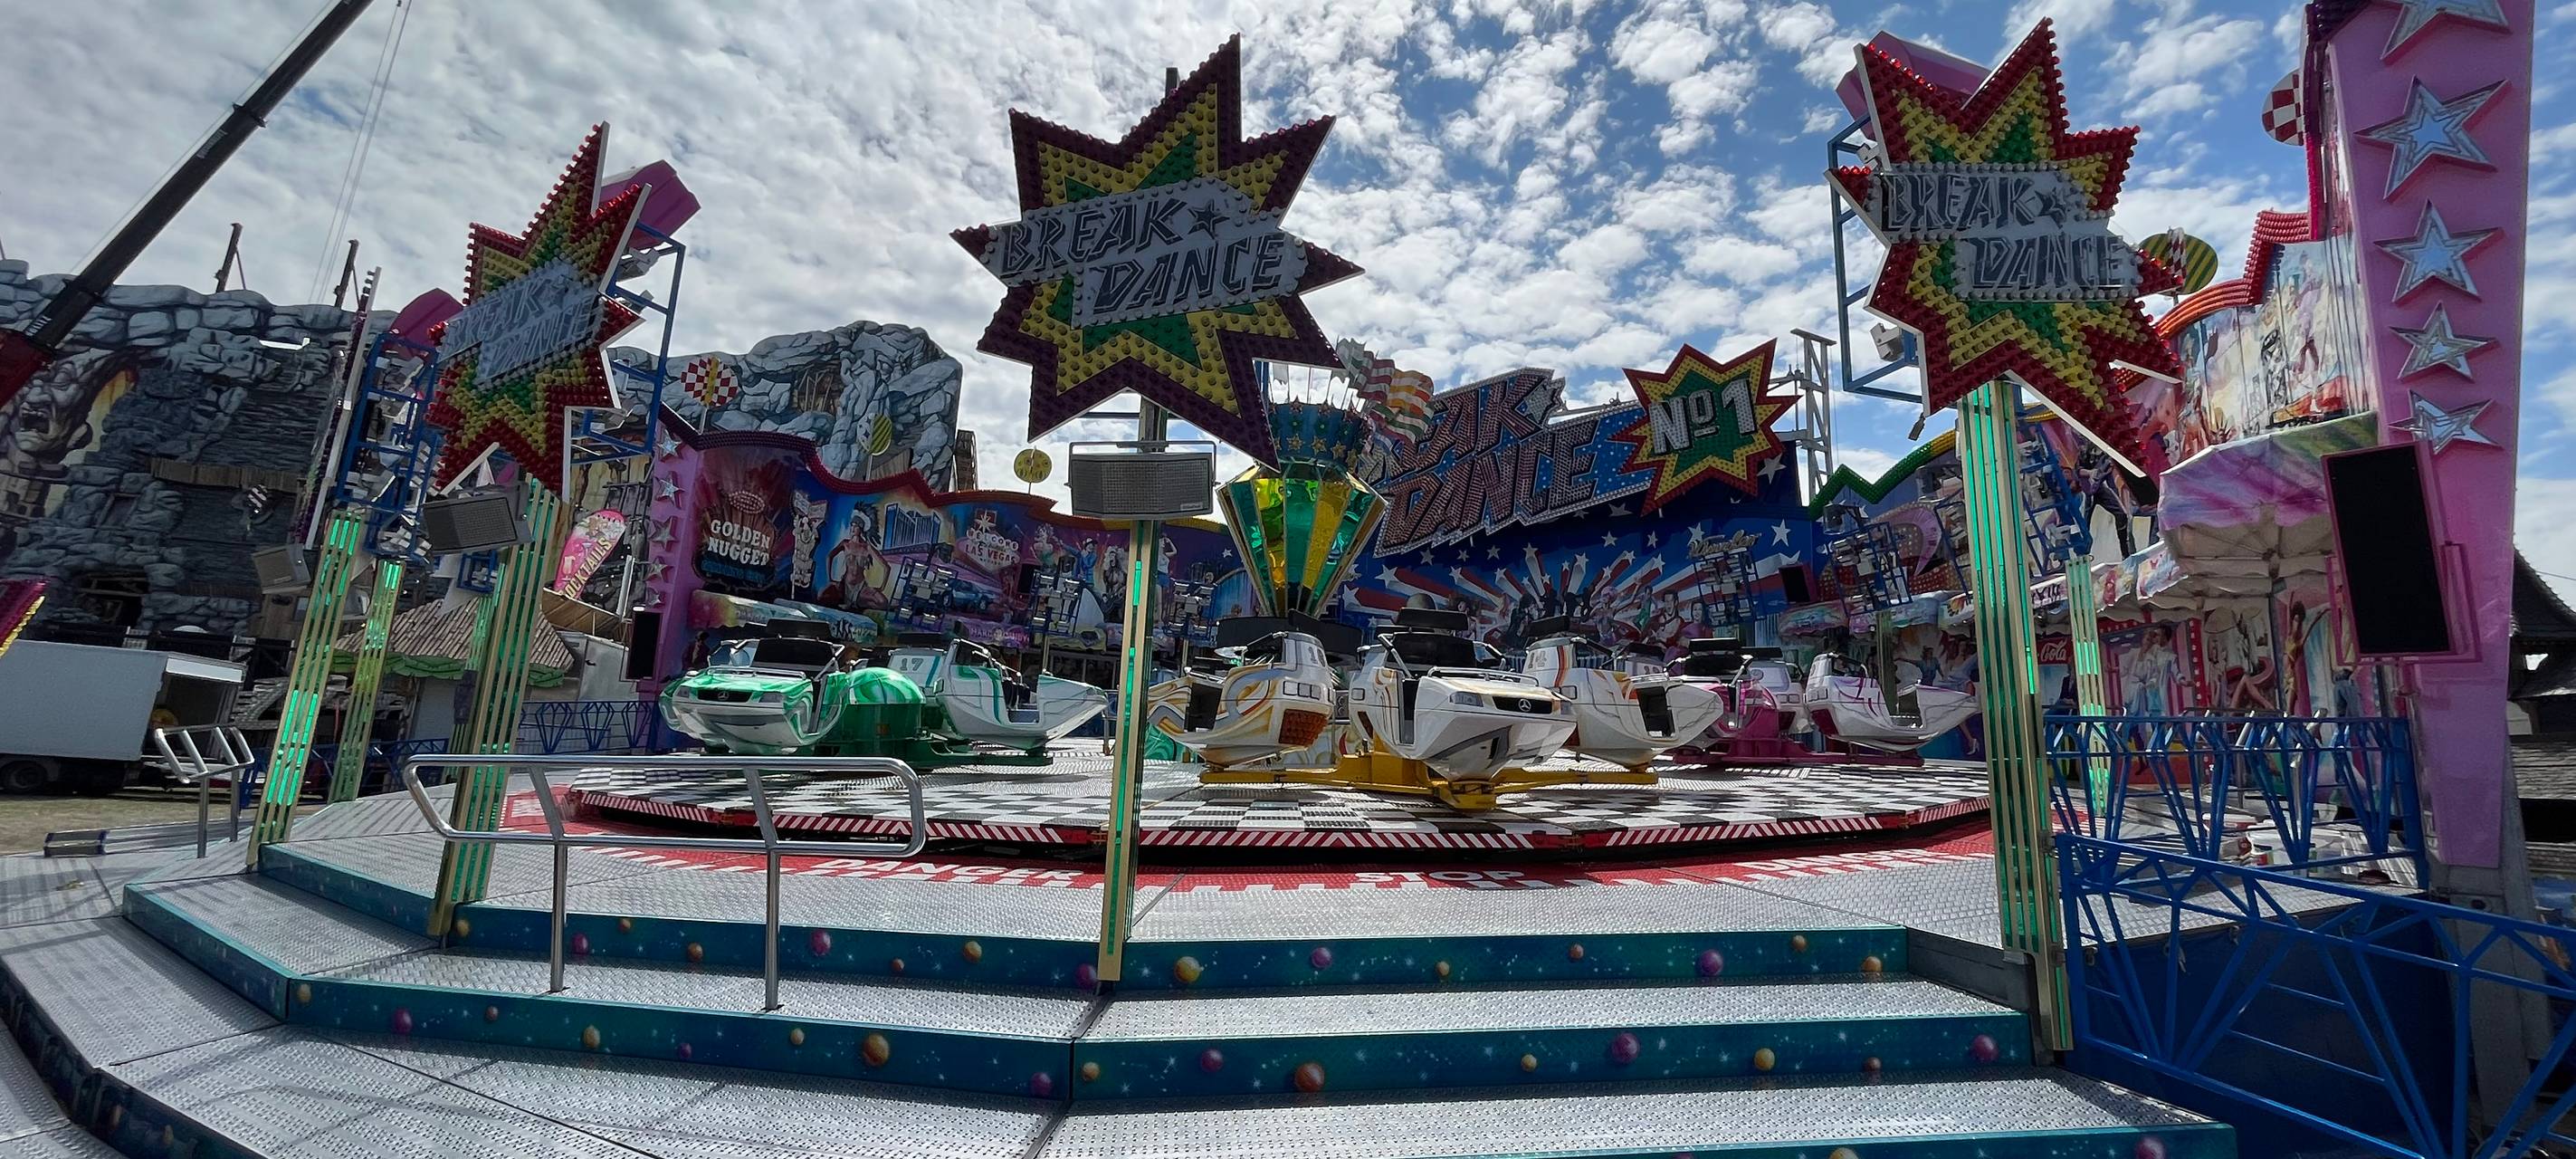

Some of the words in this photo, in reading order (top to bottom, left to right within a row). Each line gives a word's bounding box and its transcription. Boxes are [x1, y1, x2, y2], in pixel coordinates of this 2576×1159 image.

[1881, 174, 2035, 231] BREAK
[1000, 199, 1187, 274] BREAK
[1973, 235, 2123, 288] DANCE
[1090, 232, 1283, 314] DANCE
[445, 279, 545, 348] BREAK
[489, 296, 592, 374] DANCE
[1358, 372, 1545, 481] EAK
[1722, 378, 1755, 435] 1
[1381, 418, 1598, 549] DANCE
[707, 536, 769, 566] NUGGET
[711, 519, 771, 549] GOLDEN
[965, 544, 983, 556] LAS
[987, 549, 1016, 565] VEGAS
[558, 537, 613, 599] OCKTAILS
[900, 657, 924, 671] 17
[2040, 640, 2067, 662] Cola
[815, 858, 1084, 881] DANGER
[1354, 870, 1525, 883] STOP
[1732, 848, 1946, 872] DANGER
